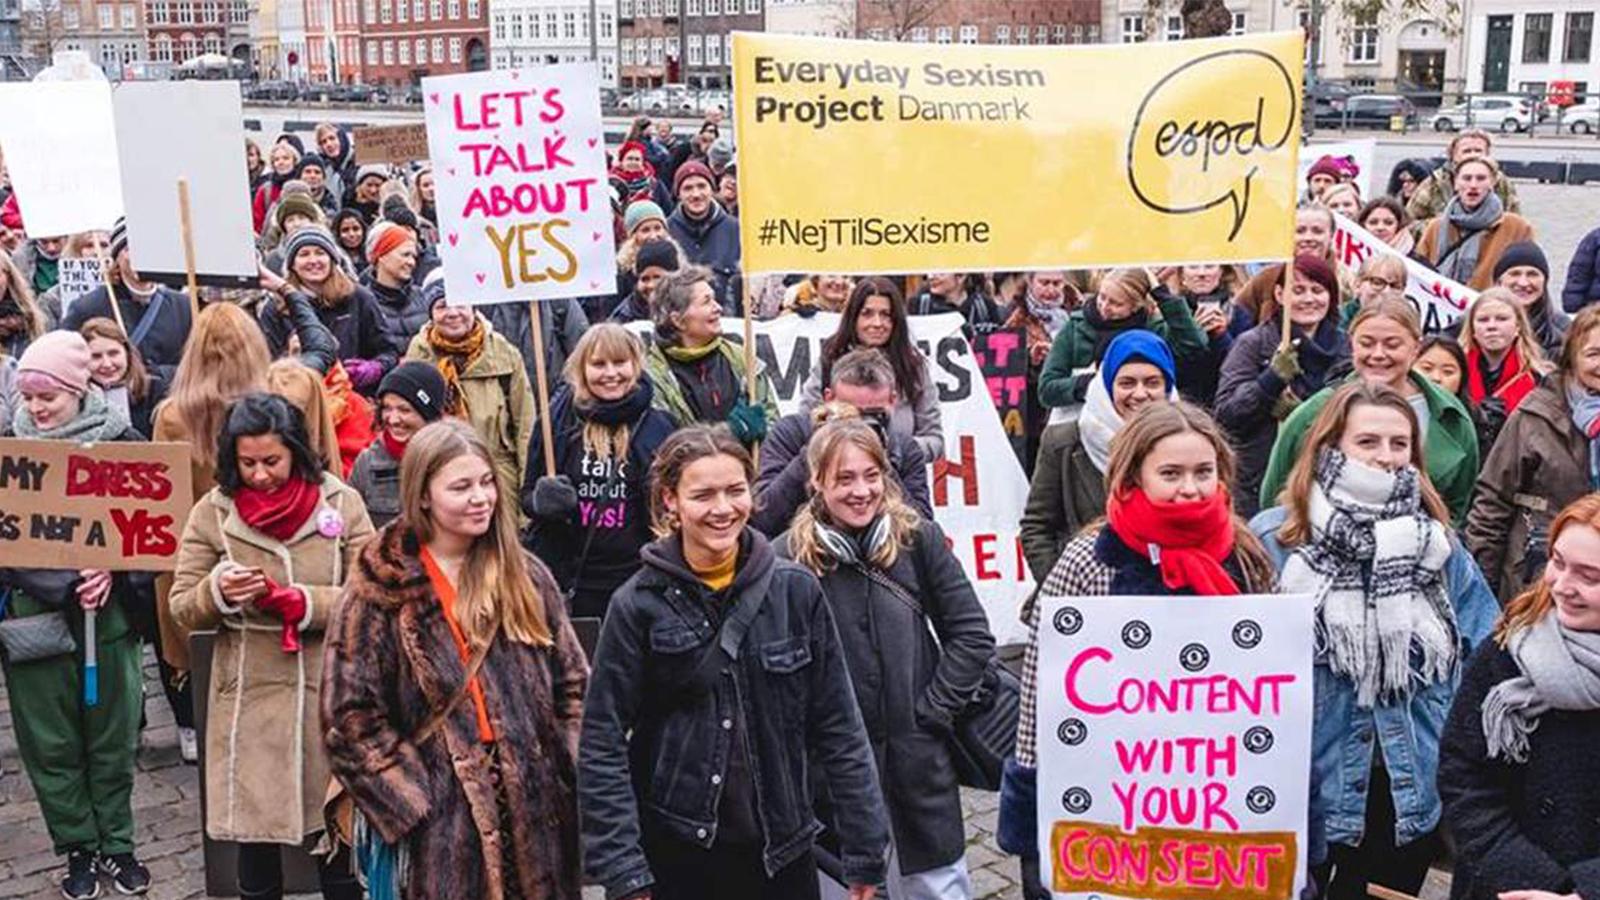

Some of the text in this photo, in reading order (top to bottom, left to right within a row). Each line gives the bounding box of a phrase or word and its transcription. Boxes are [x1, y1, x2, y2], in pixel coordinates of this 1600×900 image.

[755, 56, 1045, 88] Everyday Sexism
[453, 88, 564, 130] LET'S
[756, 94, 1030, 129] Project Danmark
[1155, 97, 1264, 172] espd
[459, 136, 574, 177] TALK
[462, 179, 597, 217] ABOUT
[485, 218, 578, 288] YES
[758, 217, 990, 252] #NejTilSexisme
[0, 455, 173, 501] MY DRESS
[30, 514, 81, 542] NOT
[85, 521, 106, 548] A
[110, 508, 178, 557] YES
[1115, 735, 1236, 777] WITH
[1112, 781, 1239, 831] YOUR
[1060, 830, 1284, 889] CONSENT
